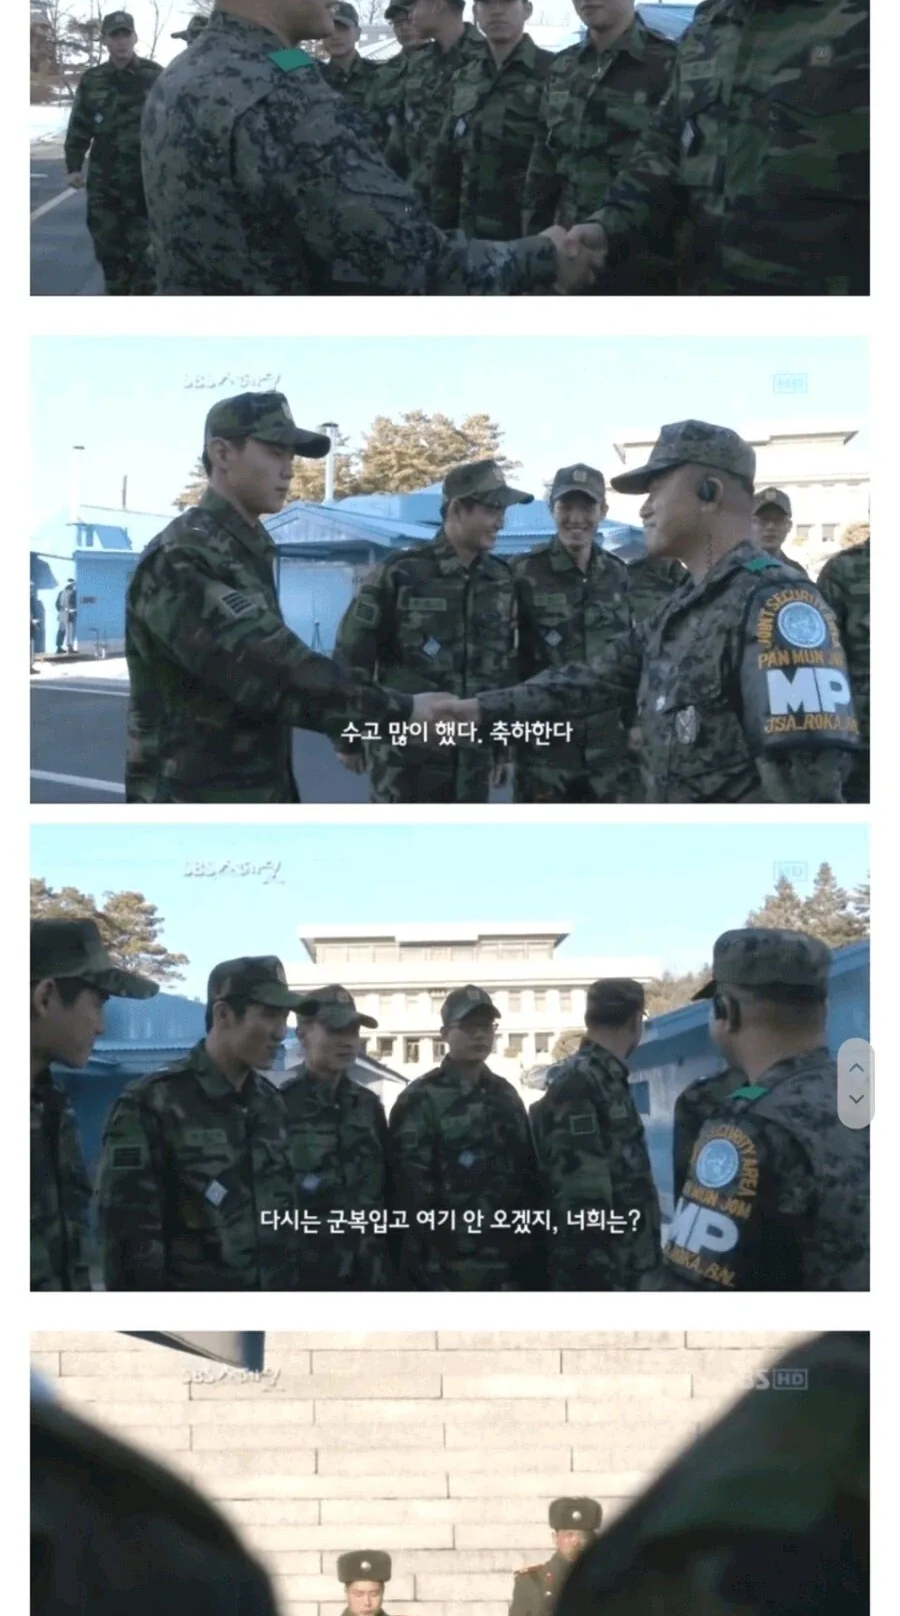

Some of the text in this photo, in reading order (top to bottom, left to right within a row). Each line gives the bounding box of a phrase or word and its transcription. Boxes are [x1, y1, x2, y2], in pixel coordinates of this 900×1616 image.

[758, 650, 790, 669] PAN
[792, 650, 825, 665] MUN
[766, 667, 851, 715] MP
[660, 1197, 740, 1253] MP
